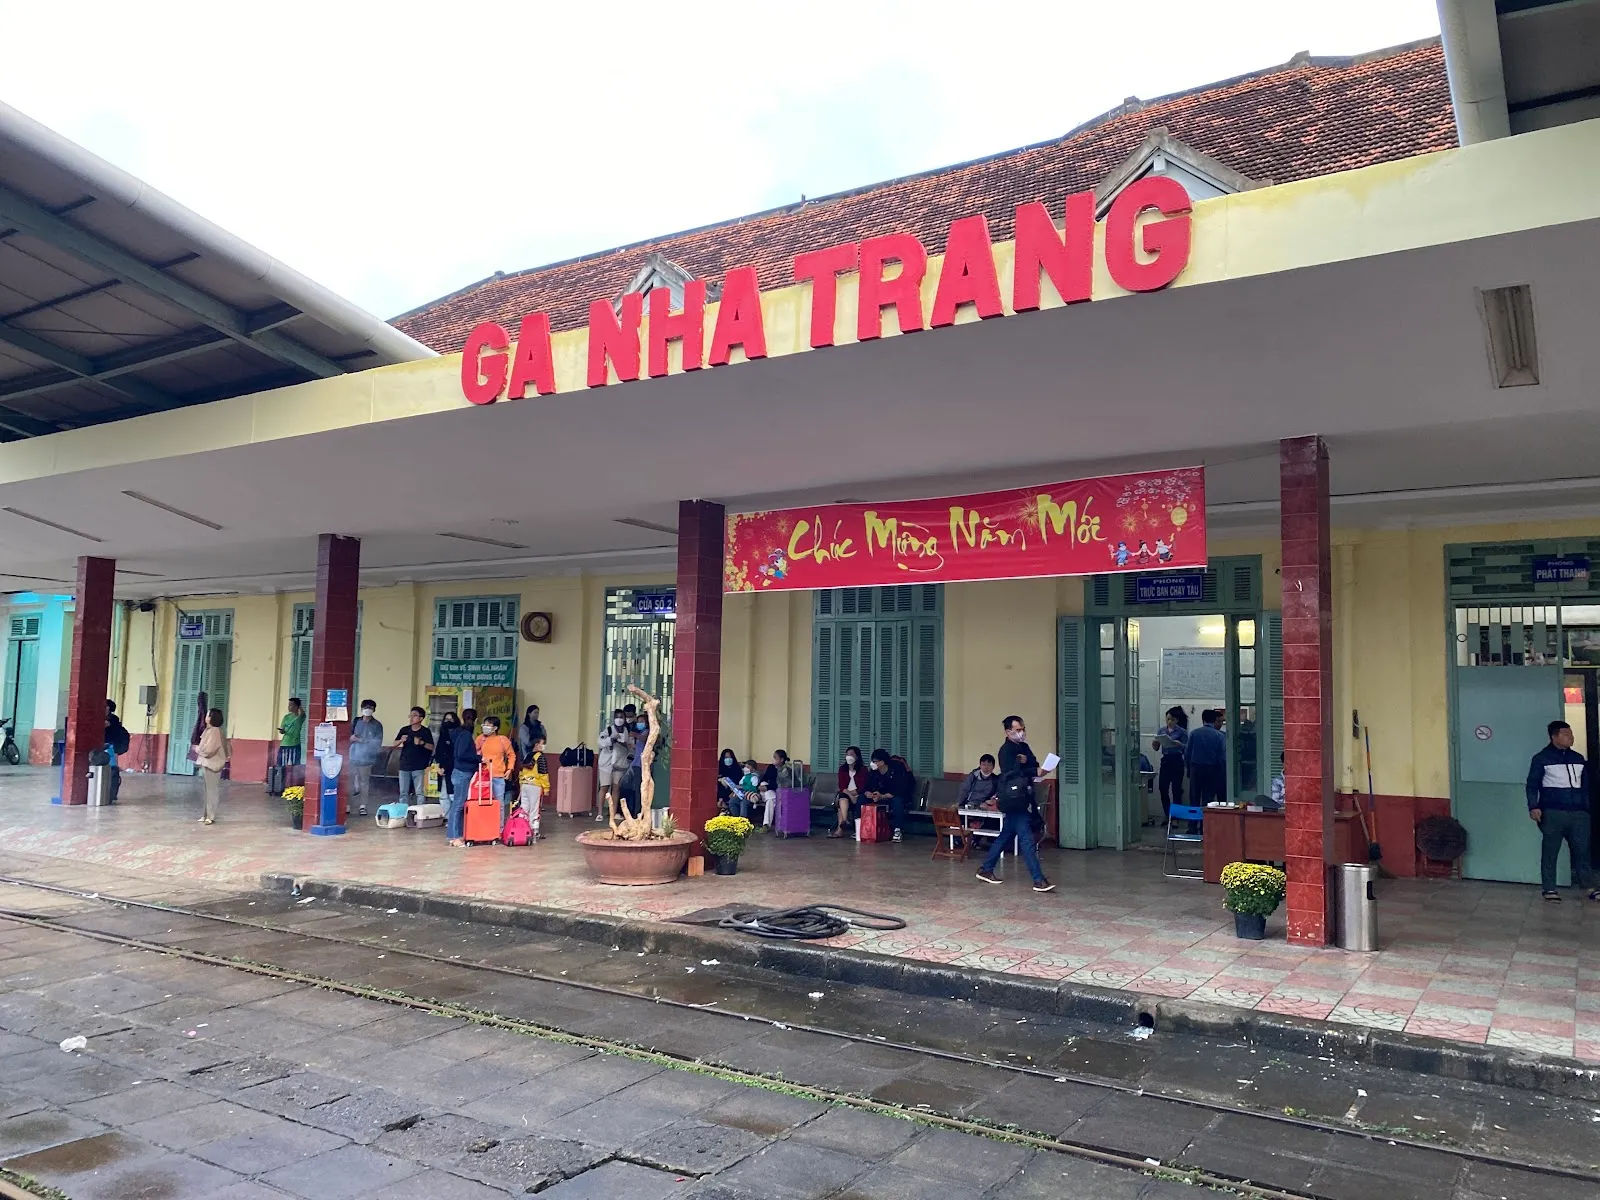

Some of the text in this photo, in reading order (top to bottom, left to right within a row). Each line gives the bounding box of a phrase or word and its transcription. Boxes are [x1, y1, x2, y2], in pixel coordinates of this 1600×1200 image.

[461, 175, 1193, 405] GA NHA TRANG
[788, 514, 857, 565] Chúc
[949, 506, 1027, 555] Năm
[1036, 494, 1107, 550] Mới
[666, 599, 672, 610] 2
